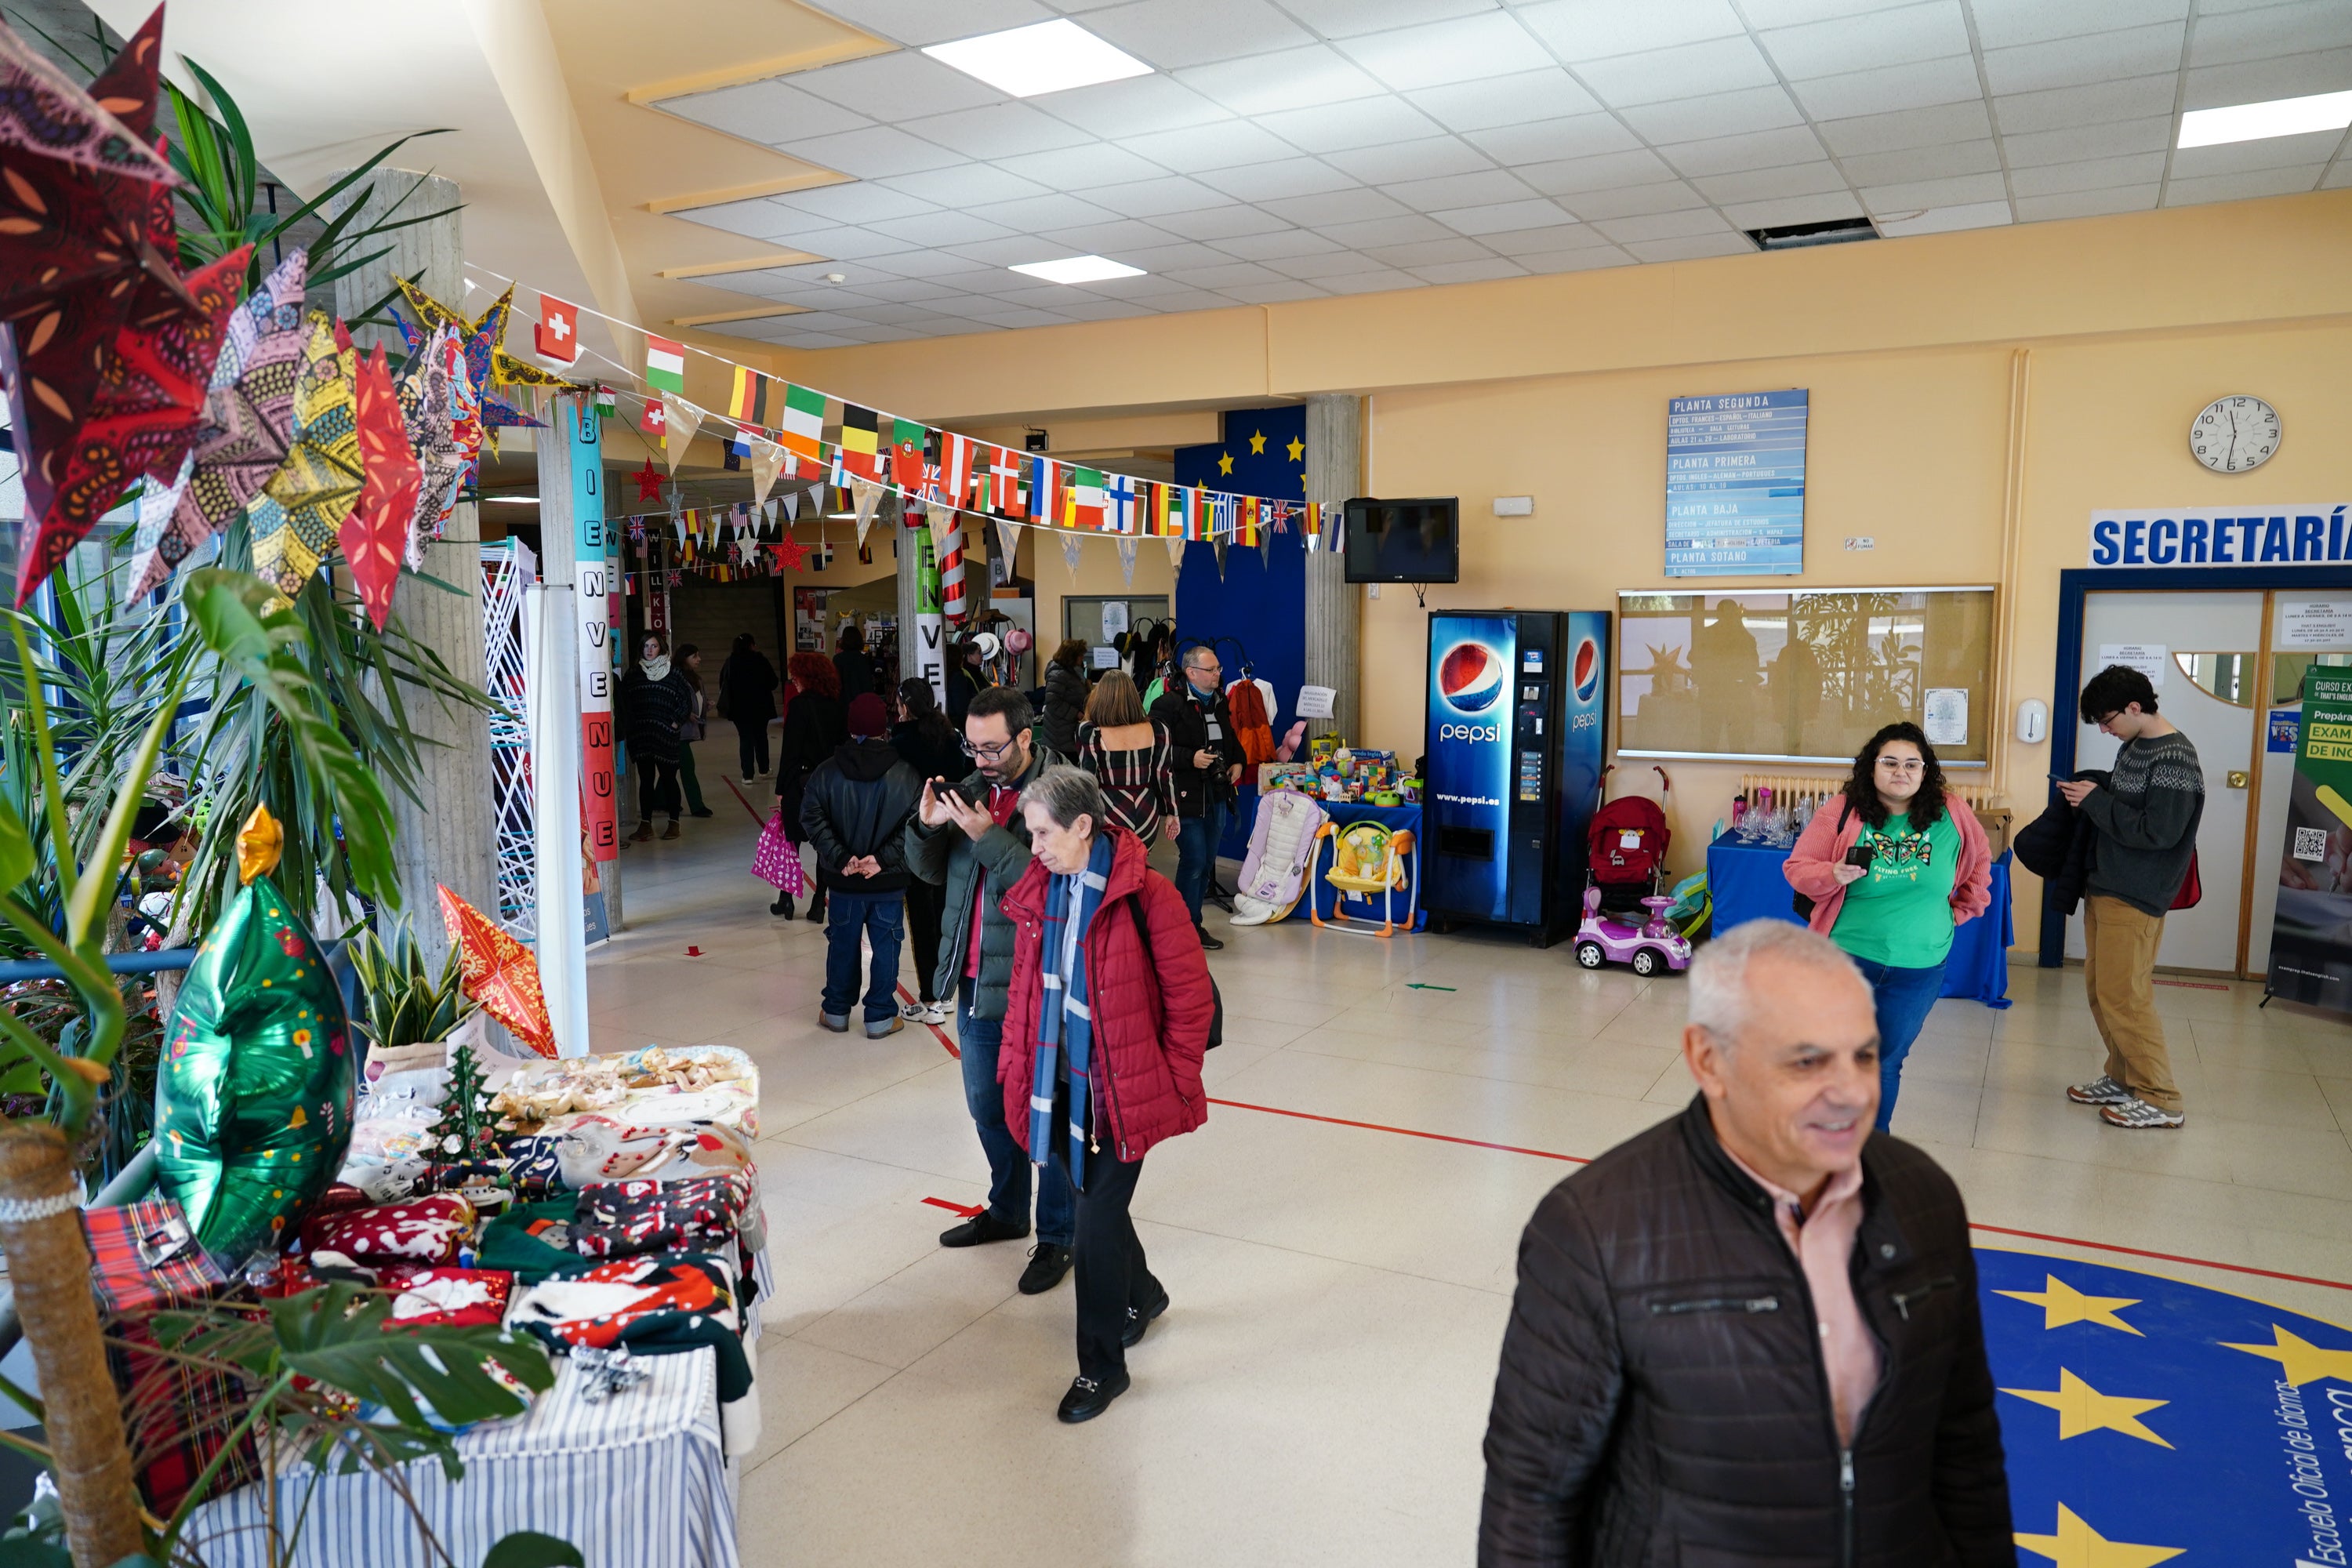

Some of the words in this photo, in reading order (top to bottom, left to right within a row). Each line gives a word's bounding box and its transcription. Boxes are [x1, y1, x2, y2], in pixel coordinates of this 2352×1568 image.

[1675, 400, 1711, 412] PLANTA
[1719, 396, 1769, 409] SEGUNDA
[2232, 397, 2246, 408] 12
[2215, 404, 2223, 413] 11
[2201, 415, 2214, 424] 10
[2264, 413, 2274, 423] 2
[1719, 432, 1756, 441] LABORATORIO
[2194, 430, 2203, 439] 9
[2268, 429, 2278, 438] 3
[2197, 445, 2207, 455] 8
[2259, 445, 2270, 455] 4
[1673, 457, 1709, 470] PLANTA
[1715, 455, 1756, 467] PRIMERA
[2210, 457, 2219, 466] 7
[2246, 456, 2256, 466] 5
[1671, 505, 1708, 517] PLANTA
[1713, 503, 1738, 515] BAJA
[1743, 517, 1769, 526] ESTUDIOS
[1671, 553, 1706, 563] PLANTA
[1711, 551, 1747, 562] SOTANO
[648, 532, 663, 629] WILLKO
[579, 416, 614, 848] BIENVENUE
[2315, 681, 2339, 691] CURSO
[2341, 682, 2352, 692] EX
[2321, 691, 2336, 700] THAT'S
[1572, 708, 1597, 733] pepsi
[1439, 723, 1501, 745] pepsi
[2271, 726, 2299, 742] YES
[2310, 745, 2330, 756] DE
[1436, 793, 1500, 806] www.pepsi.es
[1874, 866, 1899, 875] FLYING
[1900, 865, 1918, 874] FREE
[2280, 1430, 2315, 1450] de
[2283, 1449, 2328, 1499] Oficial
[2297, 1499, 2347, 1566] Escuela
